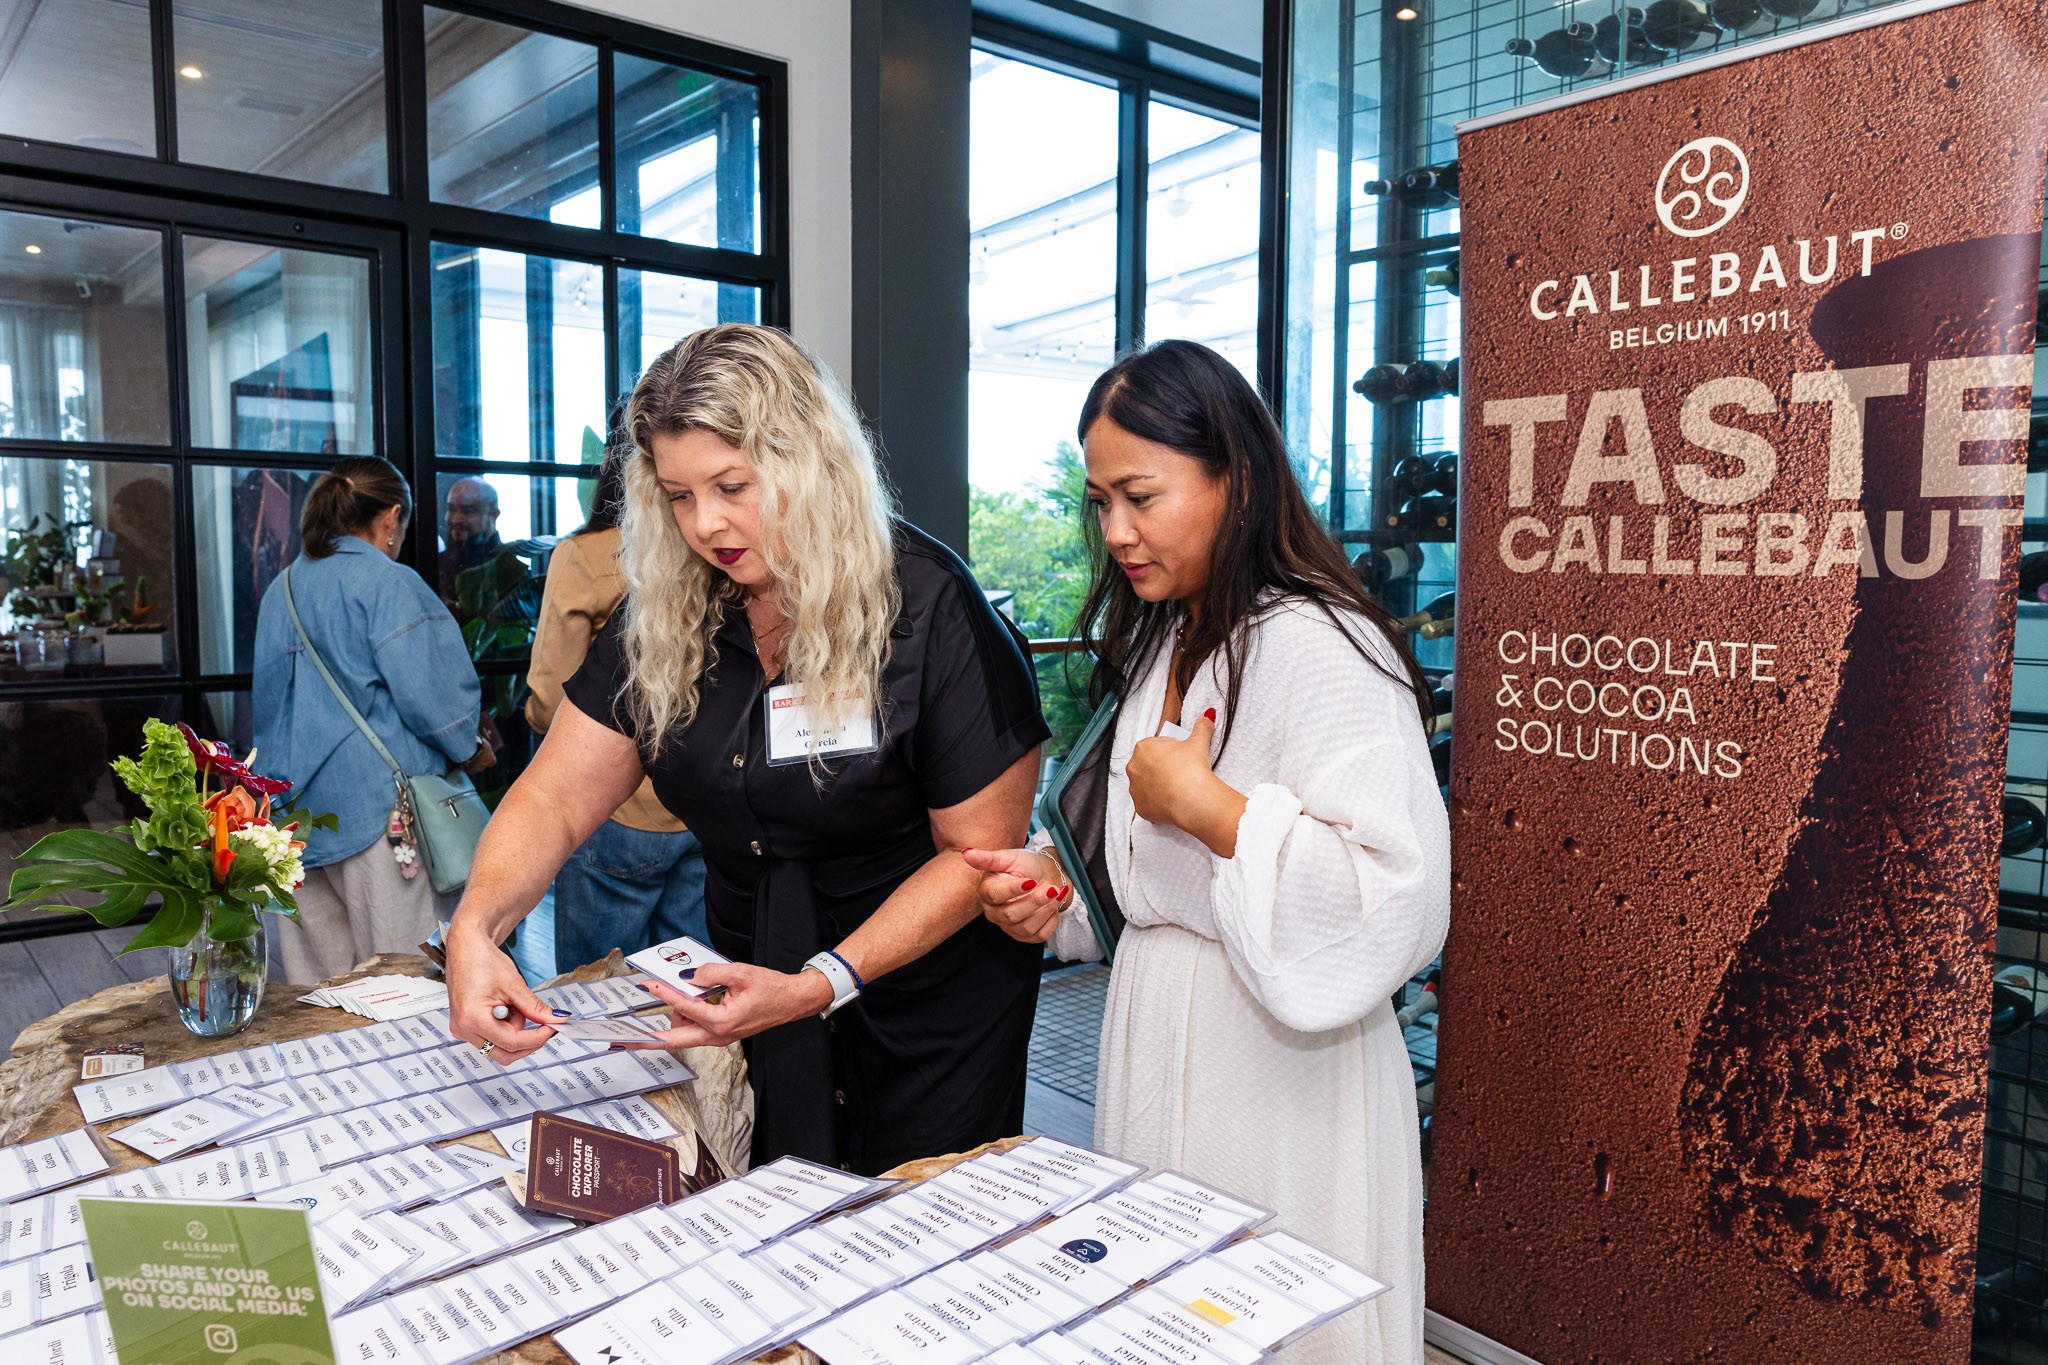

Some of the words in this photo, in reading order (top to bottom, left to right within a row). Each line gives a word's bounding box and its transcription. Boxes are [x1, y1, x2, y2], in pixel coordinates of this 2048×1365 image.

[1609, 316, 1728, 351] BELGIUM
[1738, 311, 1790, 338] 1911
[1482, 354, 2033, 508] TASTE
[1500, 508, 2023, 581] CALLEBAUT
[1498, 630, 1777, 682] CHOCOLATE
[1494, 717, 1742, 780] SOLUTIONS
[572, 1138, 582, 1198] CHOCOLATE
[1048, 1160, 1077, 1171] Hinds
[1066, 1151, 1097, 1163] Santos
[197, 1172, 208, 1186] Max
[216, 1162, 231, 1186] Santiago
[584, 1145, 594, 1196] EXPLORER
[929, 1192, 967, 1210] Sanchez
[971, 1185, 1006, 1200] Charles
[1013, 1190, 1048, 1206] Ospina
[1117, 1201, 1156, 1222] Montero
[1164, 1198, 1201, 1213] Alvarez
[701, 1213, 732, 1237] Ledesma
[921, 1213, 950, 1228] Lopez
[968, 1211, 997, 1226] Keller
[1096, 1216, 1149, 1242] Oyarzabal
[1163, 1221, 1197, 1238] Garcia
[661, 1226, 686, 1246] Padilla
[851, 1232, 894, 1258] Salamone
[876, 1230, 908, 1250] Daniel
[891, 1224, 920, 1244] Negron
[1097, 1229, 1120, 1242] Ariel
[163, 1240, 236, 1253] CALLEBAUT
[830, 1252, 847, 1263] Lee
[842, 1242, 875, 1262] Daniele
[140, 1264, 208, 1281] SHARE
[211, 1267, 269, 1284] YOUR
[575, 1256, 605, 1283] Giuseppe
[597, 1254, 619, 1273] Russo
[795, 1264, 818, 1281] Marin
[1037, 1262, 1070, 1281] Arthur
[1052, 1255, 1085, 1274] Cullen
[1270, 1260, 1304, 1285] Medina
[60, 1265, 77, 1291] Frigola
[535, 1270, 560, 1295] Gustavo
[552, 1259, 582, 1292] Fernandes
[1004, 1273, 1040, 1295] Chiong
[1254, 1265, 1292, 1290] Adriana
[104, 1276, 188, 1295] PHOTOS
[193, 1283, 236, 1298] AND
[240, 1284, 282, 1300] TAG
[286, 1286, 315, 1302] US
[455, 1288, 477, 1309] Duque
[504, 1284, 527, 1305] Garcia
[979, 1284, 1012, 1306] Santos
[1226, 1287, 1259, 1305] Perez
[122, 1293, 153, 1308] ON
[158, 1296, 234, 1313] SOCIAL
[238, 1300, 308, 1316] MEDIA:
[485, 1289, 510, 1314] Ignacio
[947, 1298, 981, 1320] Cullen
[1204, 1288, 1255, 1319] Alejandra
[443, 1303, 469, 1329] Ignacio
[474, 1309, 496, 1331] Garcia
[668, 1308, 686, 1328] Milla
[1163, 1312, 1210, 1342] Melendez
[651, 1318, 673, 1337] Elisa
[897, 1325, 927, 1347] Carlos
[905, 1313, 946, 1342] Ferreiro
[361, 1343, 374, 1360] Ines
[374, 1328, 400, 1358] Santana
[1142, 1330, 1196, 1360] Caporale
